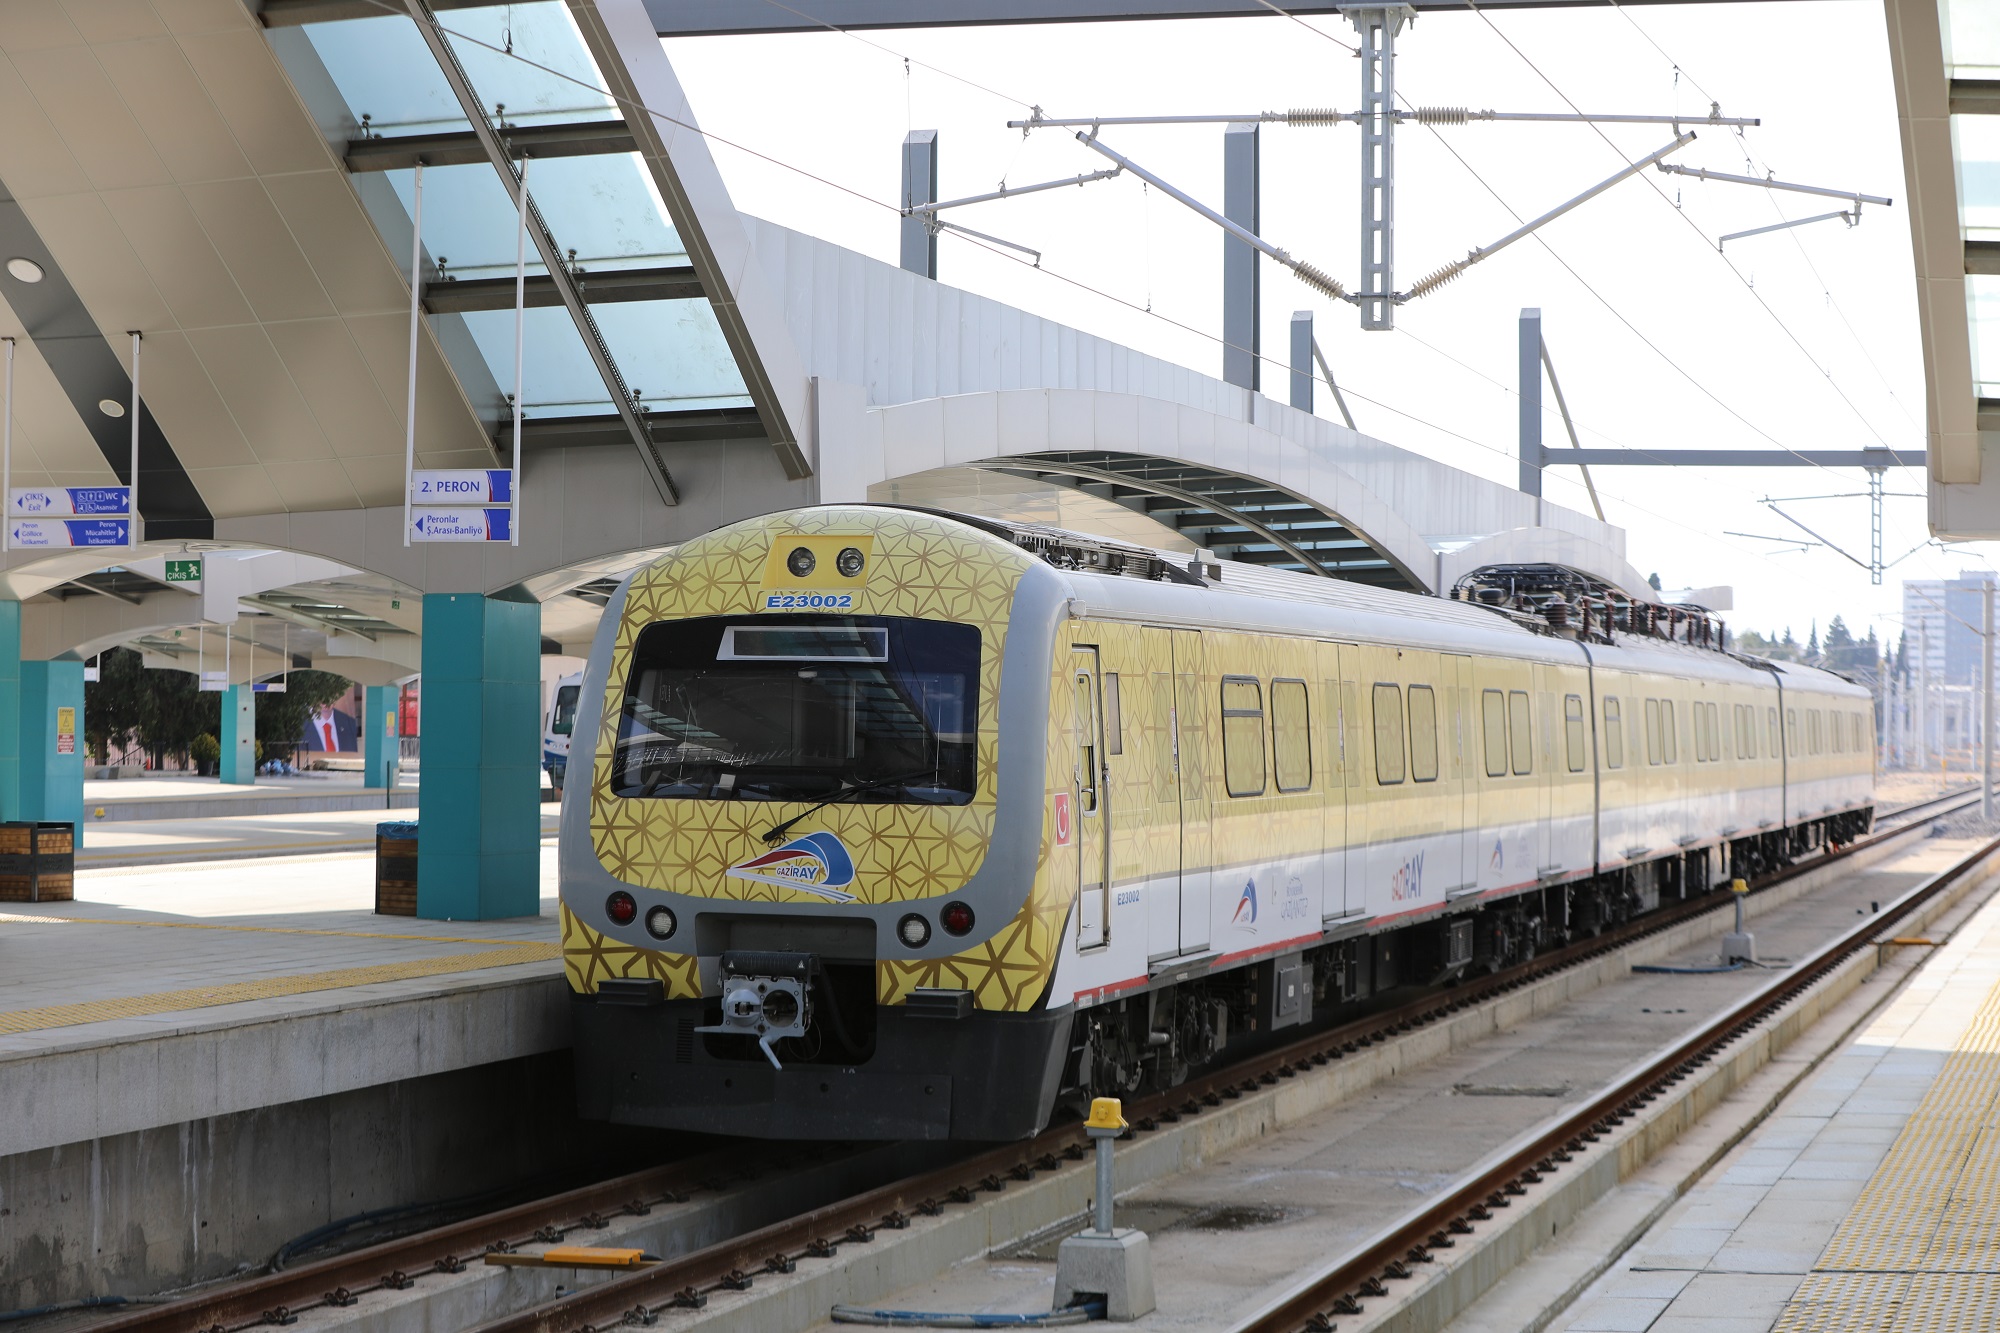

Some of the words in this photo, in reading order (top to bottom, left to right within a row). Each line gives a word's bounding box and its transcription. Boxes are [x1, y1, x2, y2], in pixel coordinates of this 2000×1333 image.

[421, 481, 432, 493] 2.
[436, 481, 480, 492] PERON
[25, 493, 44, 502] ÇIKIŞ
[105, 492, 118, 500] WC
[427, 515, 459, 523] Peronlar
[167, 572, 187, 580] ÇIKIŞ
[766, 595, 852, 608] E23002
[776, 865, 818, 880] GAZİRAY
[1117, 889, 1140, 906] E23002
